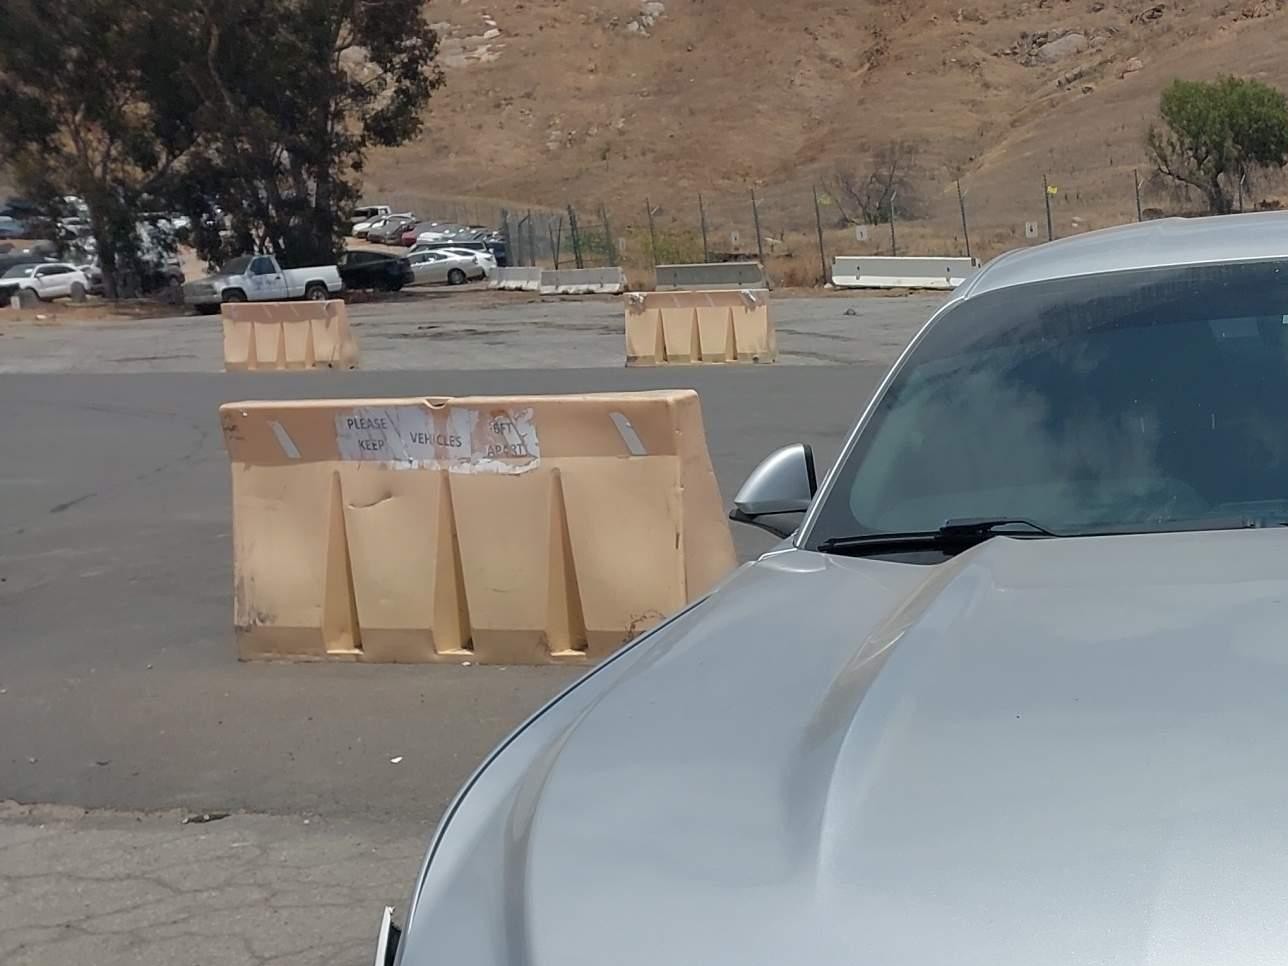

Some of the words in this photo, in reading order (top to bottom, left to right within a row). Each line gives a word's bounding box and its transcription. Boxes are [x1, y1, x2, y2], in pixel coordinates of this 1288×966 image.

[347, 418, 387, 429] PLEASE
[358, 438, 385, 451] KEEP
[410, 431, 462, 448] VEHICLES
